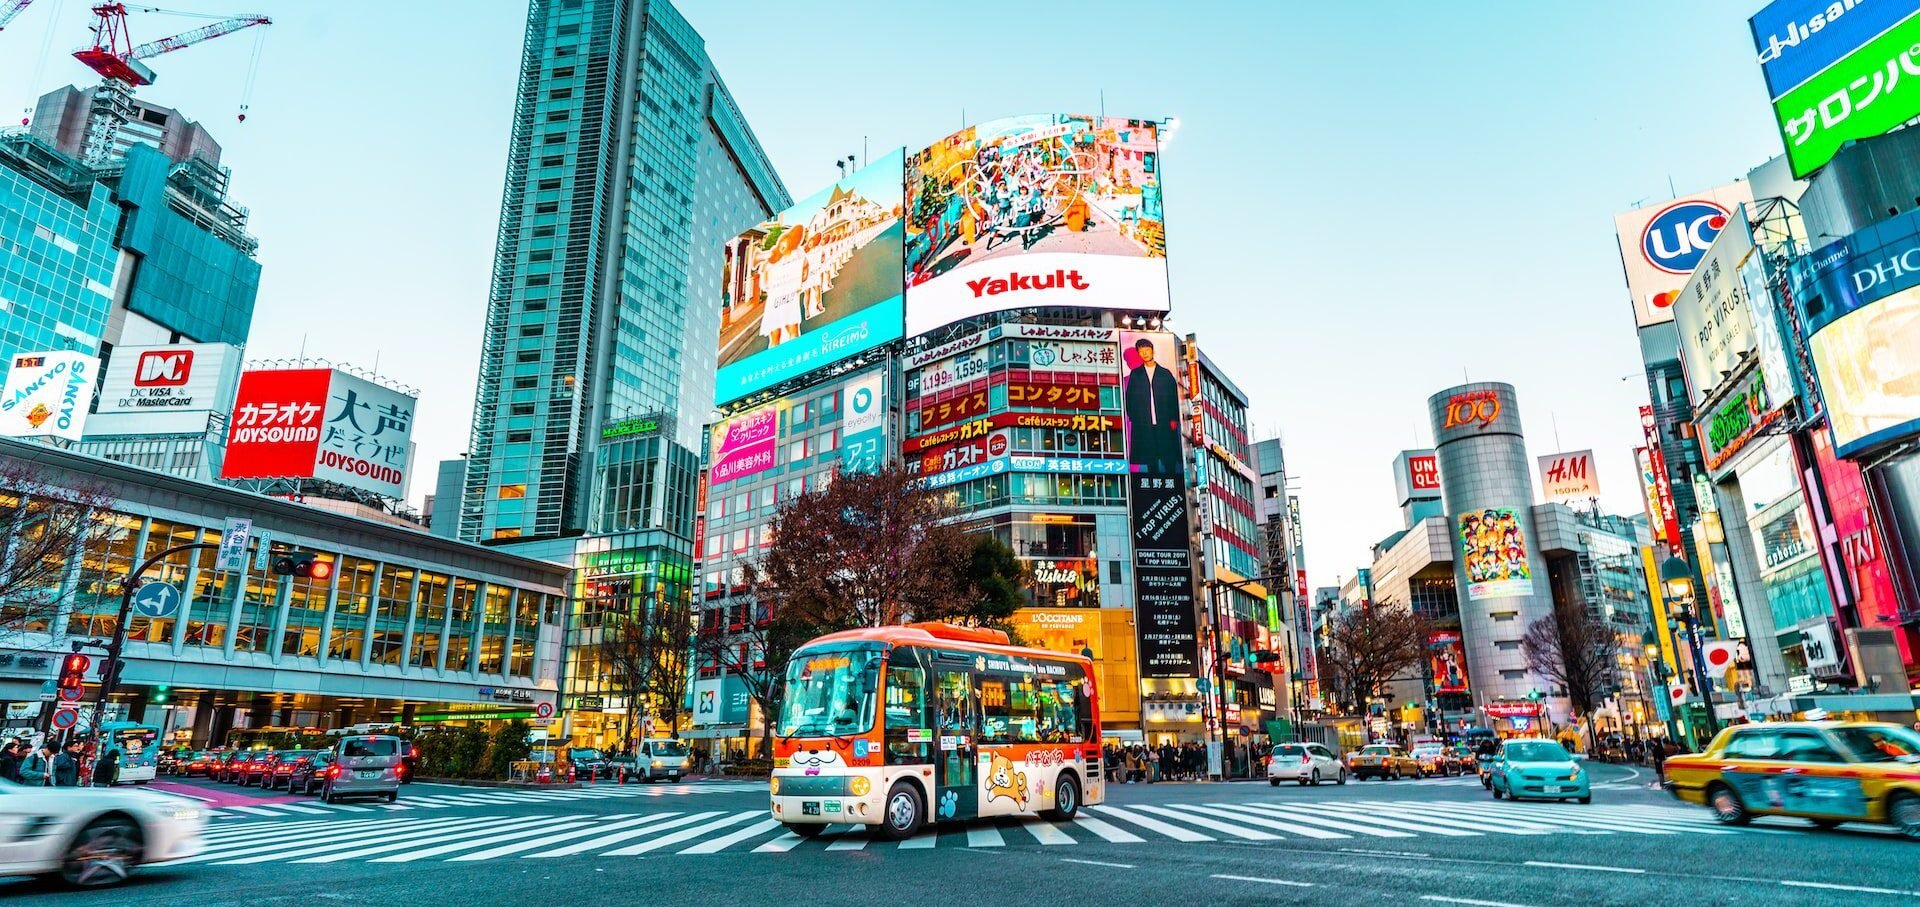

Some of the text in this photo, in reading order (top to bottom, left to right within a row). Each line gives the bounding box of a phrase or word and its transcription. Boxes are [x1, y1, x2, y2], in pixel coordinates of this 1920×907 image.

[1811, 246, 1849, 273] Channel
[1853, 248, 1920, 294] DHC
[966, 269, 1090, 298] Yakult
[1713, 288, 1740, 327] VIRUS
[1020, 325, 1113, 340] しゃぶしゃぶバイキング
[139, 354, 186, 382] DC
[1060, 347, 1114, 365] しゃぶ葉
[2, 362, 67, 412] SANKYO
[57, 360, 88, 430] SANKYO
[130, 388, 146, 397] DC
[149, 387, 171, 396] VISA
[907, 377, 919, 391] 9F
[1009, 385, 1097, 404] コンタクト
[118, 396, 193, 407] DC MasterCard
[236, 402, 321, 426] カラオケ
[327, 389, 411, 436] 大声
[923, 392, 986, 425] プライス
[1443, 397, 1501, 430] 109
[232, 426, 319, 444] JOYSOUND
[960, 418, 994, 440] ガスト
[1072, 415, 1113, 431] ガスト
[318, 449, 402, 485] JOYSOUND
[942, 444, 984, 471] ガスト
[1048, 459, 1126, 472] 英会話イーオン
[1547, 455, 1587, 483] H&M
[1555, 487, 1580, 495] 150m
[227, 522, 247, 567] 渋谷駅前
[987, 660, 1066, 676] SHIBUYA community bus HACHIKO
[1259, 687, 1276, 705] LUSH
